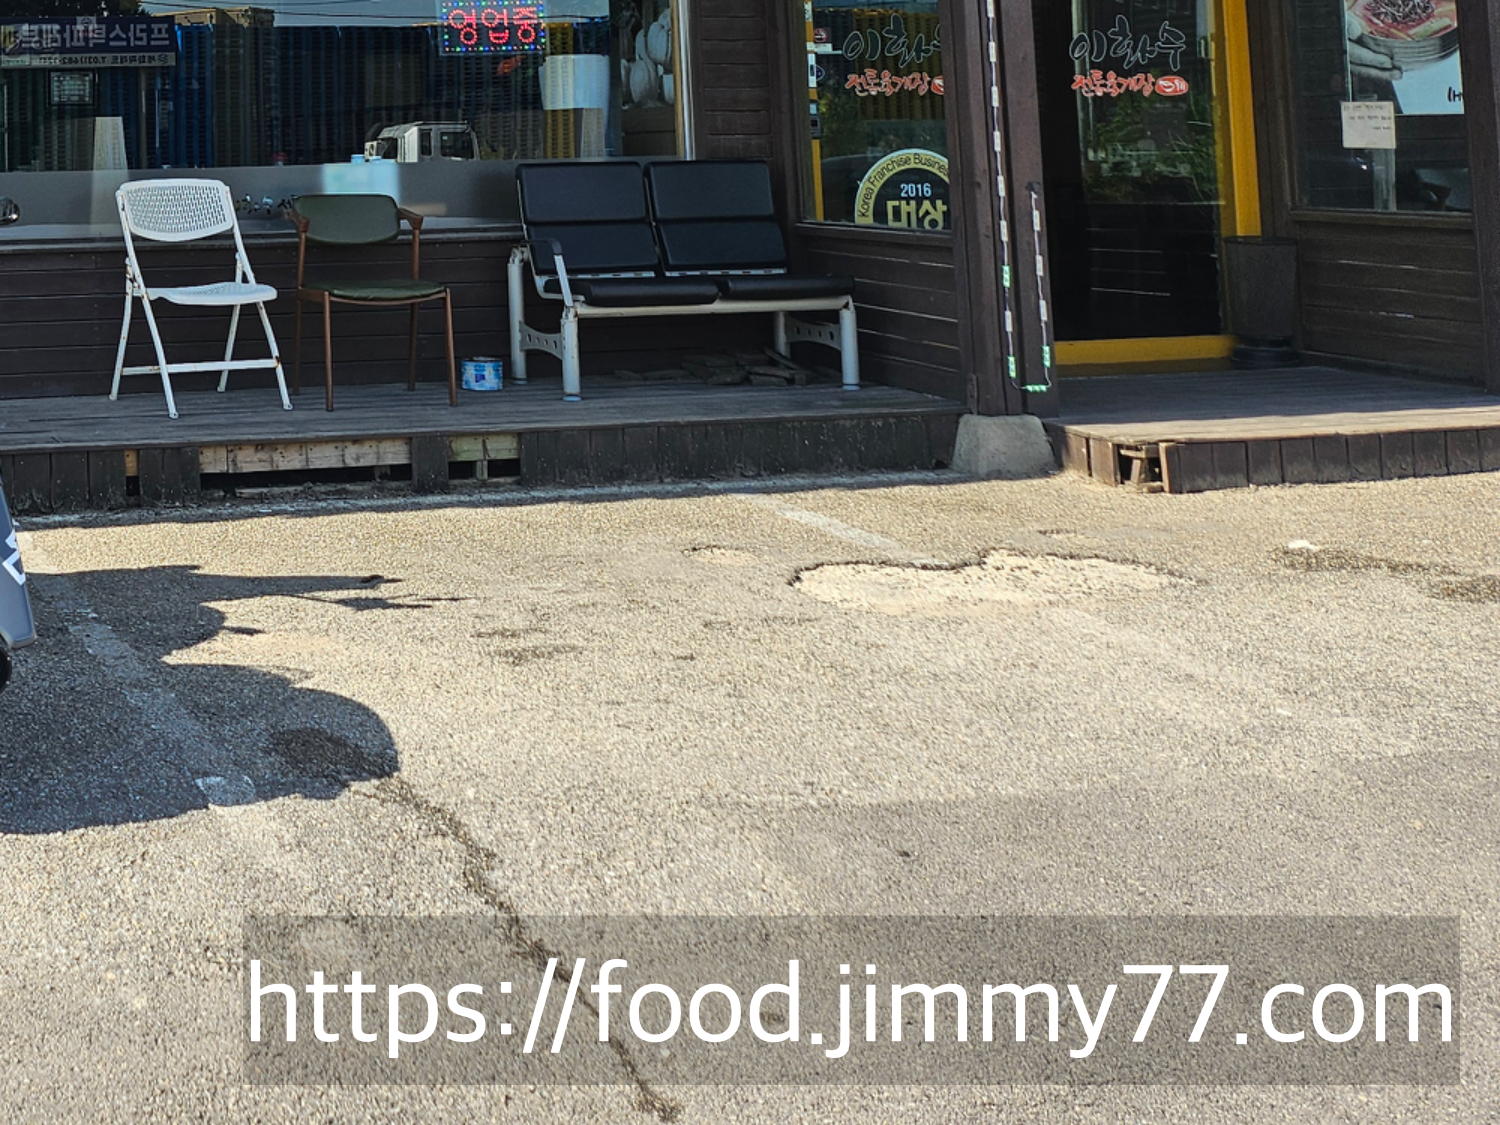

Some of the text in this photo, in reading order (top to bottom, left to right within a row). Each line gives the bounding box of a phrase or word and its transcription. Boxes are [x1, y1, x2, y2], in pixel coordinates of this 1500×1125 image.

[448, 7, 538, 45] 영업중
[1069, 15, 1186, 71] 이화수
[845, 69, 930, 96] 전통육개장
[1071, 69, 1155, 96] 전통육개장
[858, 186, 874, 218] Korea
[867, 155, 911, 188] Franchise
[900, 182, 932, 197] 2016
[886, 199, 948, 230] 대상
